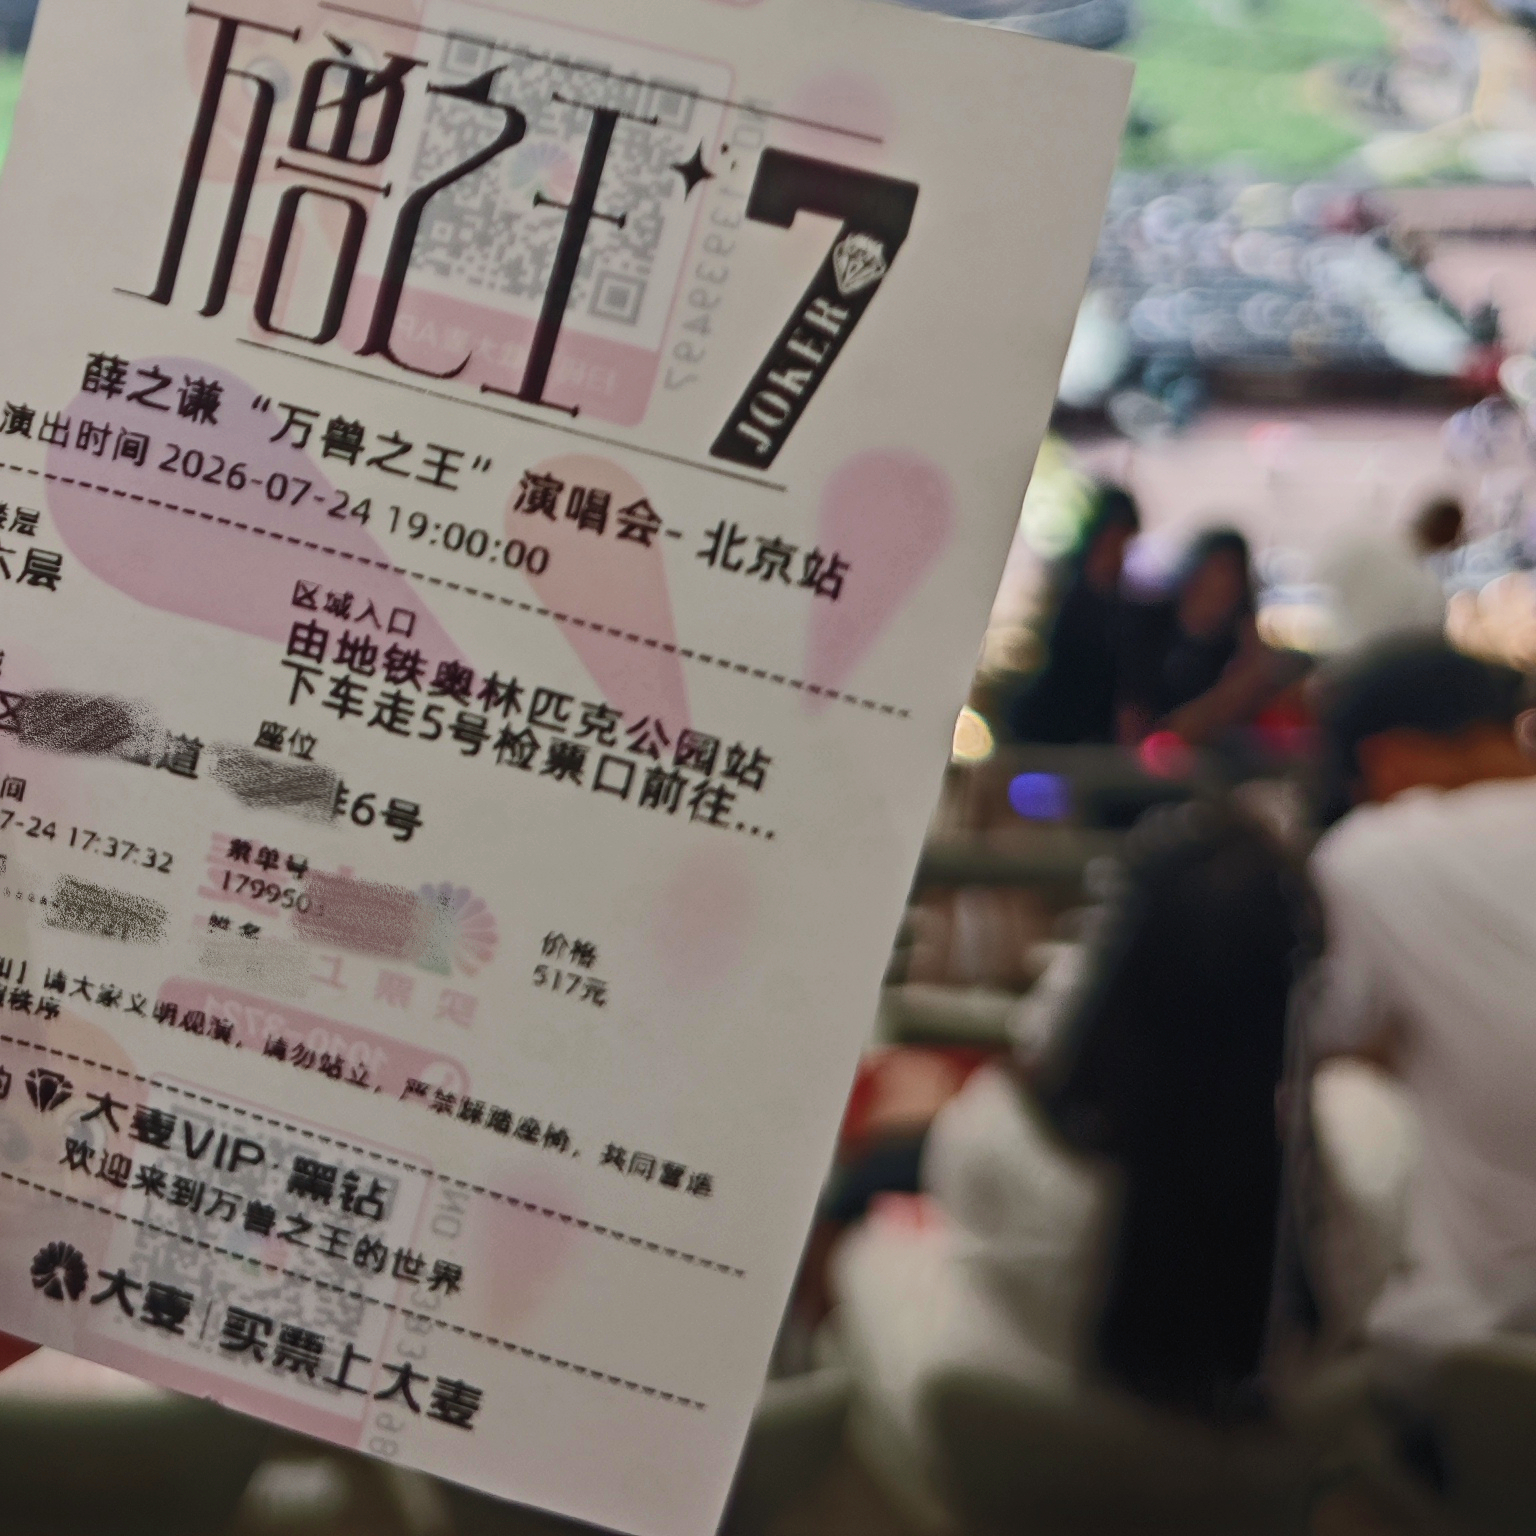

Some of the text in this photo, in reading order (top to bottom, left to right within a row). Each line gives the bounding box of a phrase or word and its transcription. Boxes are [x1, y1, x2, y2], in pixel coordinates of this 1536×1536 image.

[709, 146, 920, 471] 7
[736, 295, 851, 455] JOKER
[158, 442, 372, 527] 2026-07-24
[387, 505, 551, 577] 19:00:00
[695, 519, 852, 602] 北京站
[291, 579, 417, 639] 区域入口
[254, 720, 319, 761] 座位
[286, 619, 774, 793] 由地铁奥林匹克公园站
[68, 826, 175, 875] 17:37:32
[221, 870, 325, 916] 179950
[531, 963, 610, 1008] 517元
[540, 928, 599, 969] 价格
[59, 1136, 465, 1296] 欢迎来到万兽之王的世界
[90, 1268, 484, 1432] 大麦 买票上大麦
